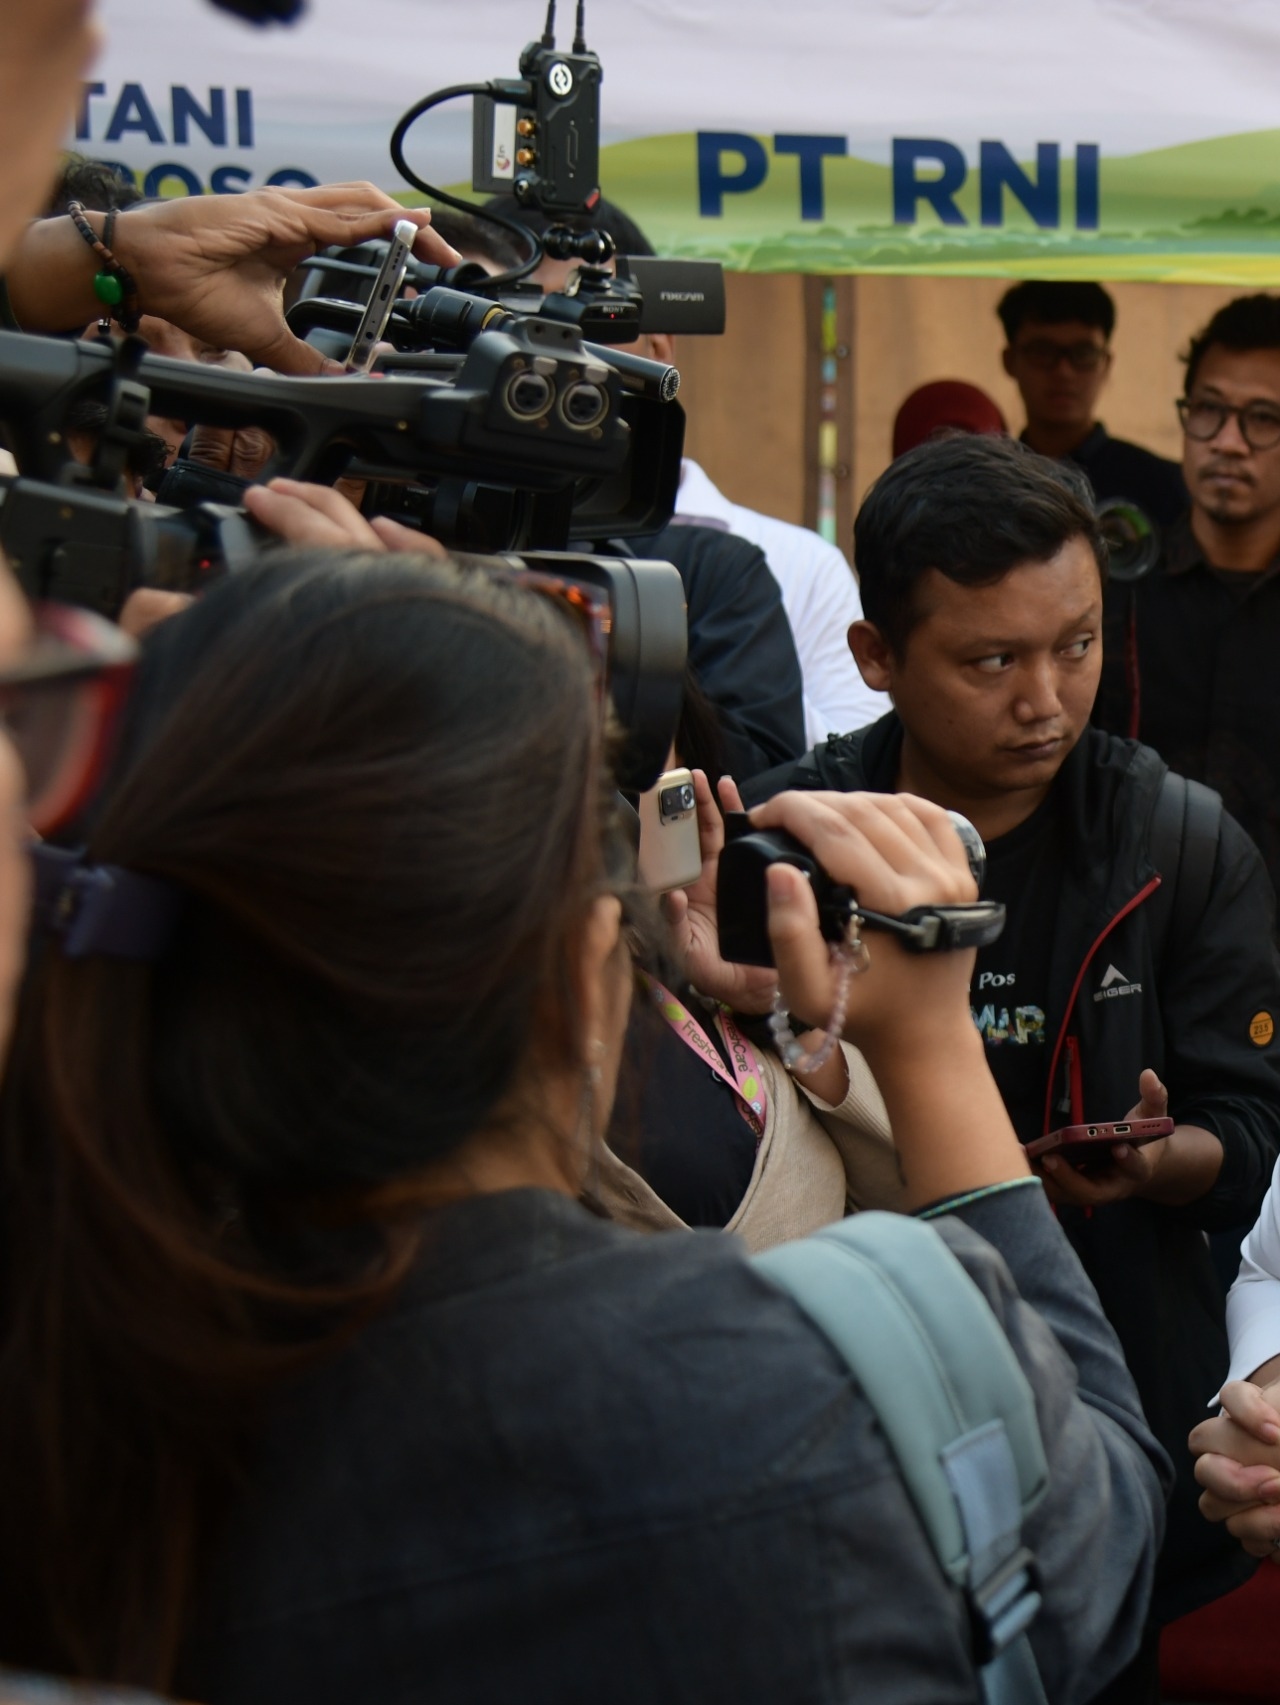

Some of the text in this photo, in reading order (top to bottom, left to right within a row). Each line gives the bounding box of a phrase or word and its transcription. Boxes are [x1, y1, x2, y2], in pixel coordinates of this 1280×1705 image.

[75, 82, 254, 149] TANI
[697, 130, 1099, 231] PT RNI
[978, 971, 1016, 990] Pos
[1093, 983, 1142, 1002] EIGER
